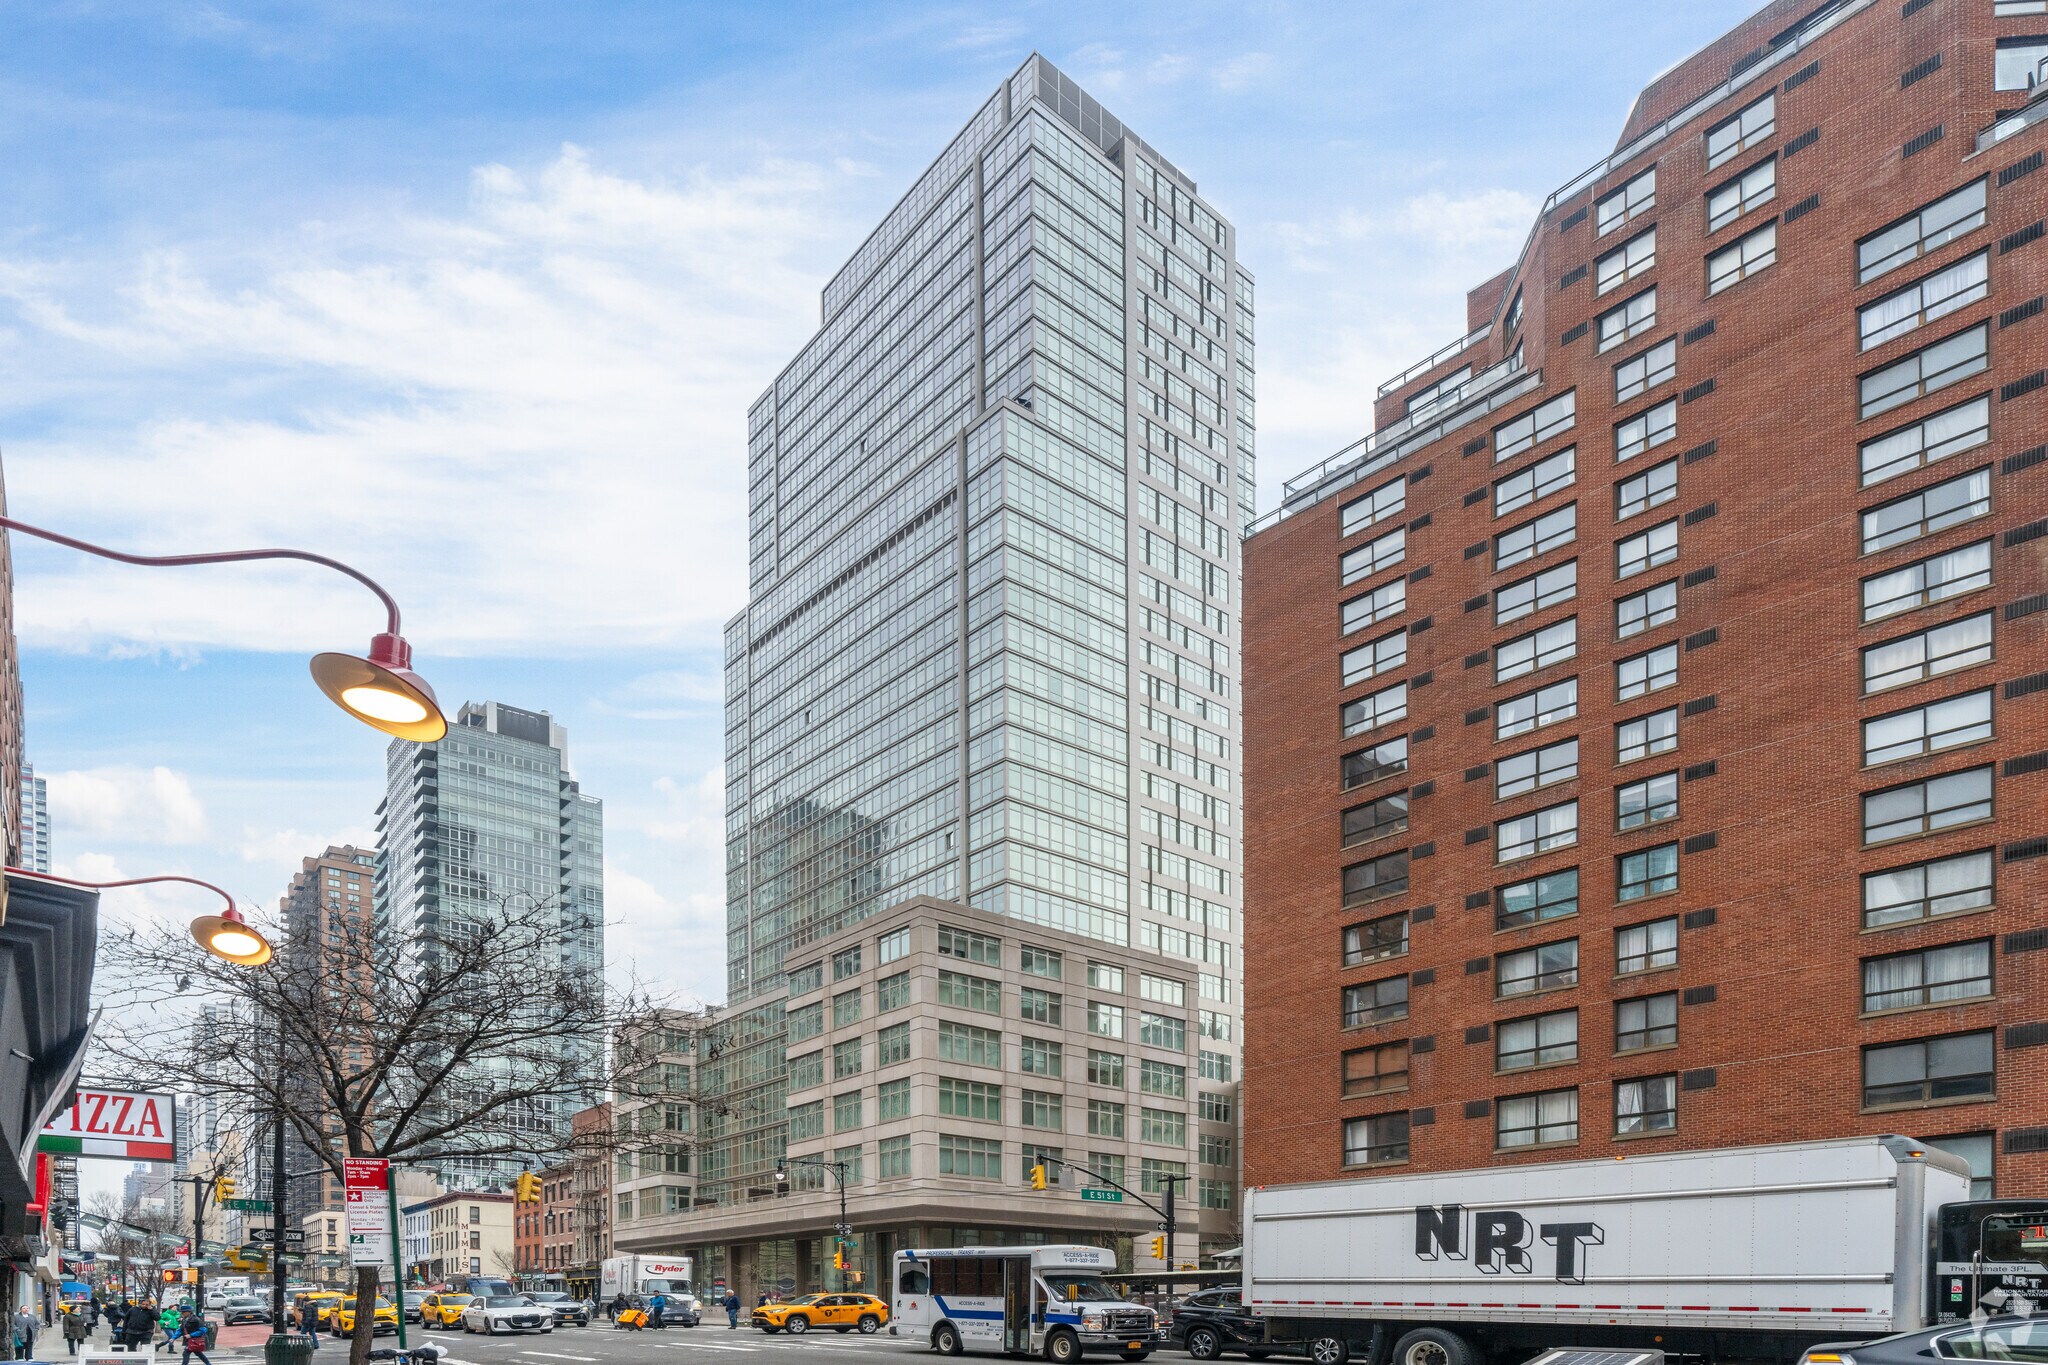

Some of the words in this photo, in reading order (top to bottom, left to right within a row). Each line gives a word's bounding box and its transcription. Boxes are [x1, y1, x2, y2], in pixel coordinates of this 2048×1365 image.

[43, 1093, 164, 1138] IZZA
[1090, 1191, 1096, 1199] E
[233, 1201, 239, 1209] E
[245, 1201, 256, 1210] 51
[353, 1235, 361, 1243] 2
[1415, 1203, 1605, 1286] NRT
[654, 1264, 685, 1273] Ryder
[2002, 1274, 2042, 1289] NRT
